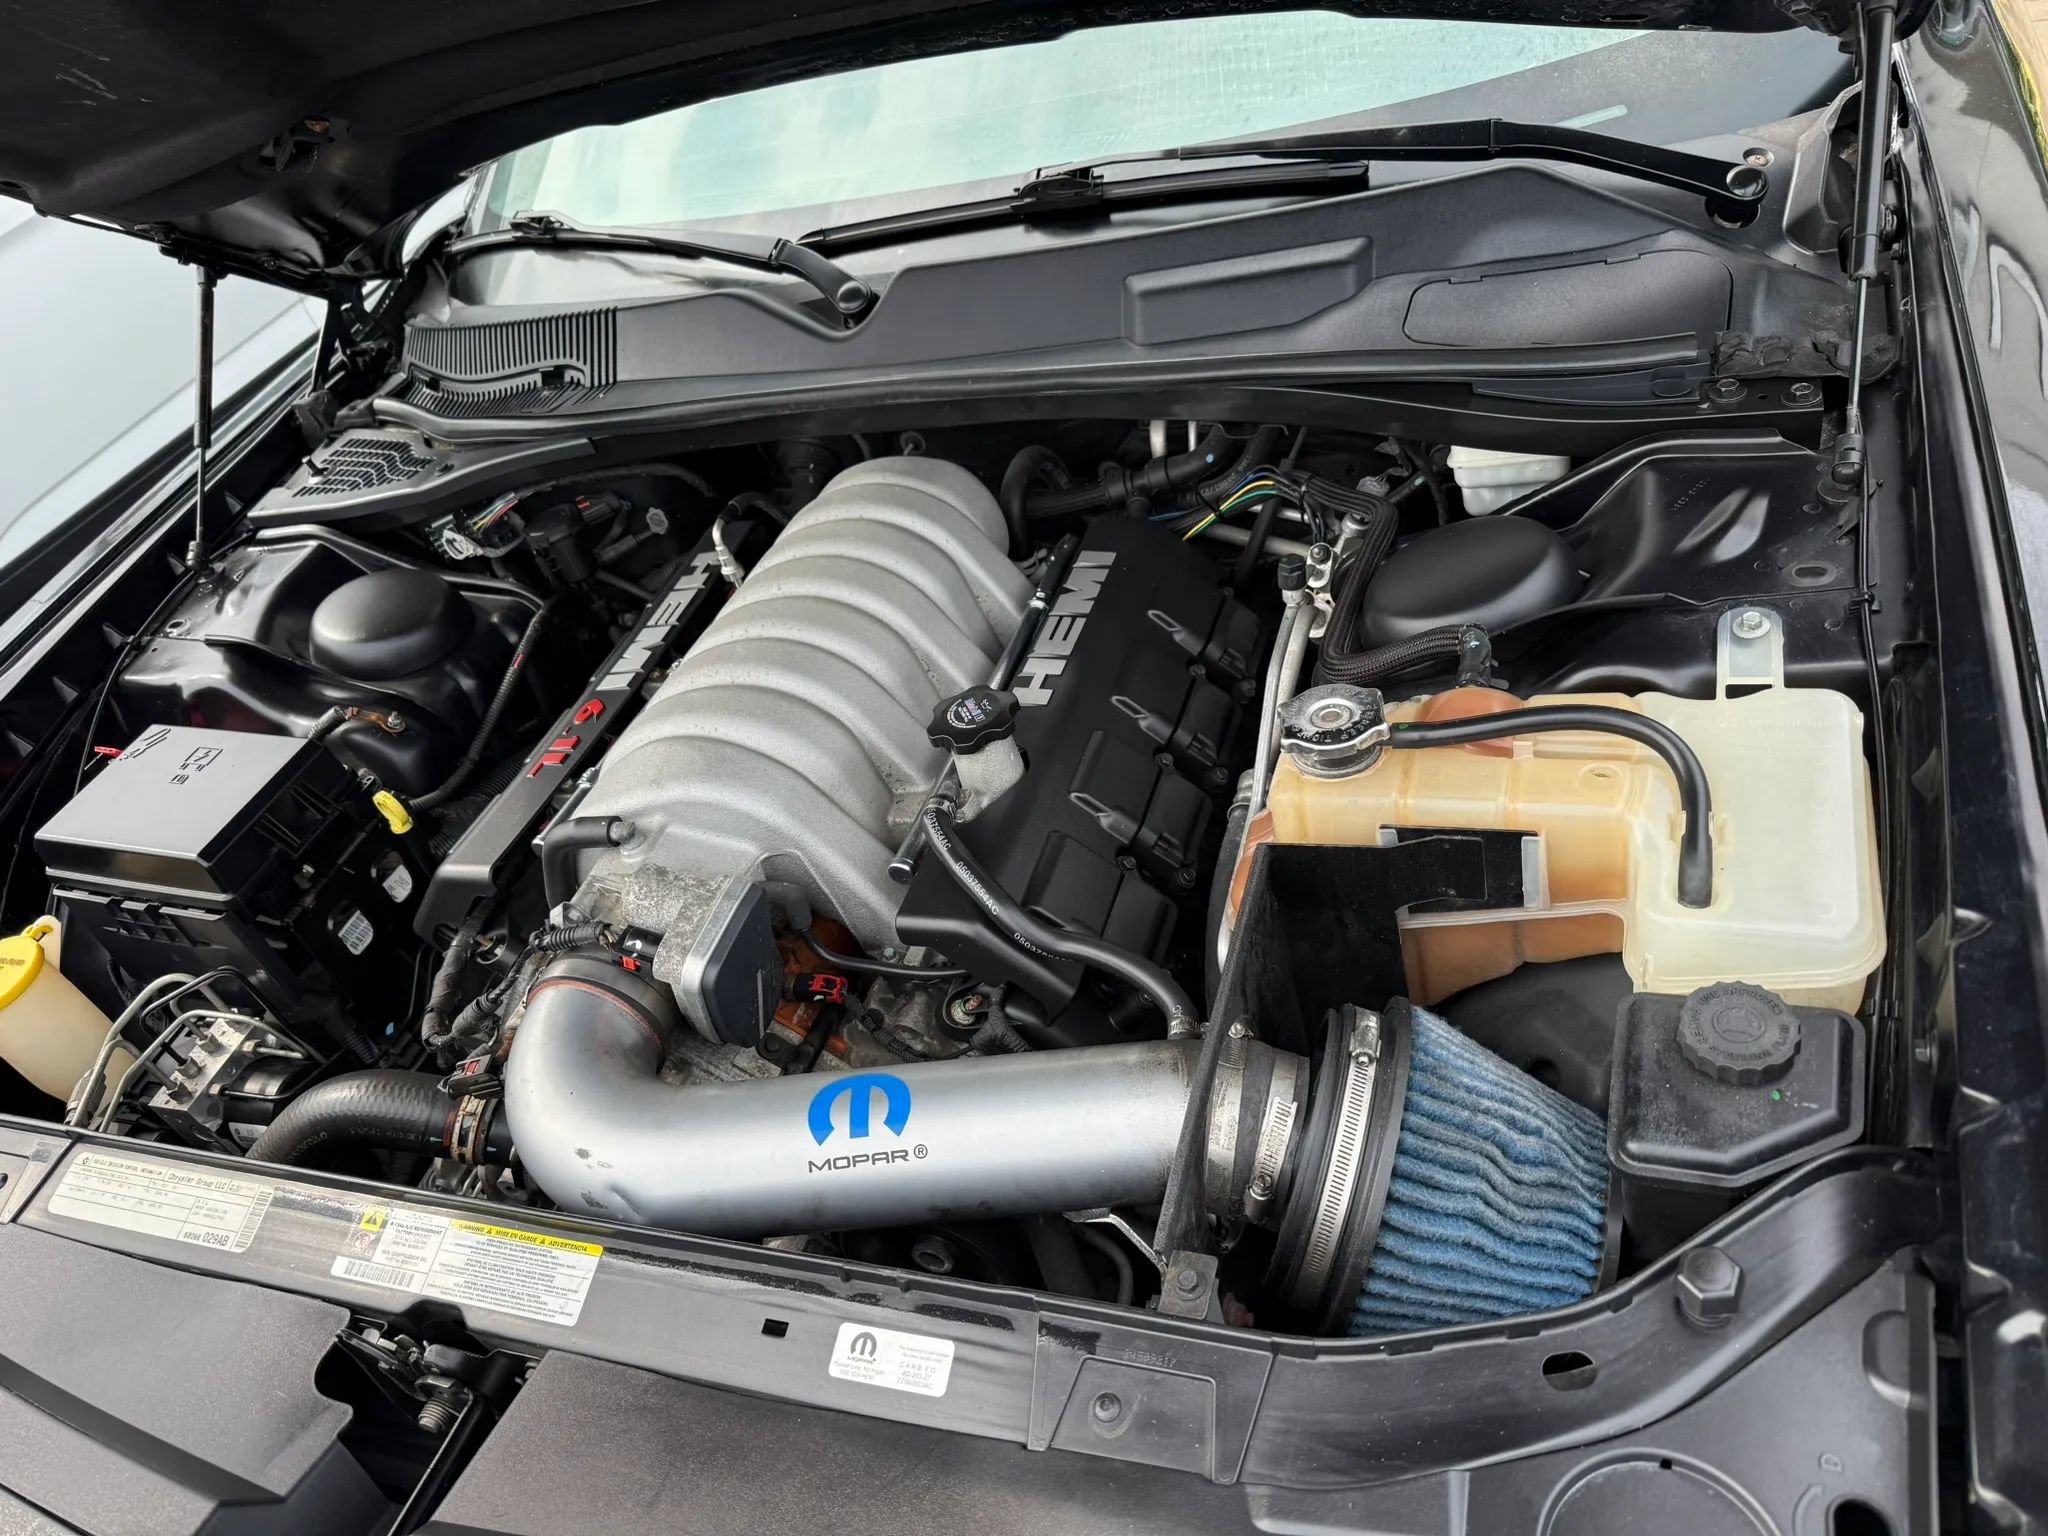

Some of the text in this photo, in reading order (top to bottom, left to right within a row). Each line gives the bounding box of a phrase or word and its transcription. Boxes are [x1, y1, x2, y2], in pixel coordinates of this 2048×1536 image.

[1012, 551, 1117, 707] HEMI
[526, 551, 722, 778] HEMI 6.1L
[956, 861, 1000, 916] 05037554AC
[166, 1172, 227, 1189] Chrysler Group LLC
[494, 1229, 510, 1238] MISE
[517, 1233, 538, 1243] GARDE
[547, 1239, 588, 1252] ADVERTENCIA
